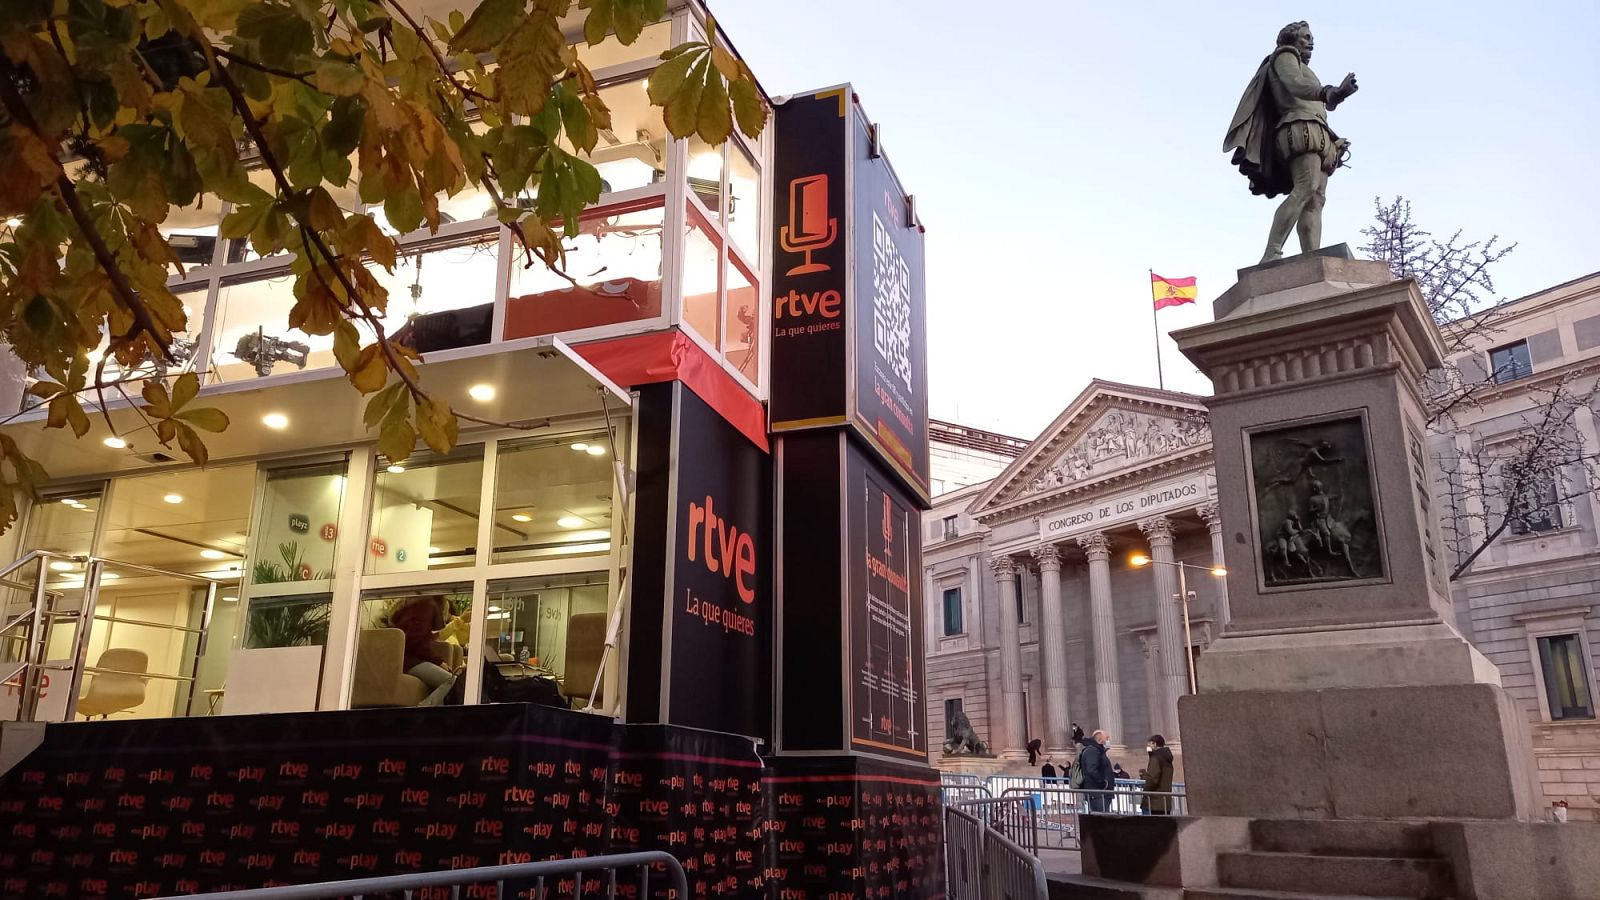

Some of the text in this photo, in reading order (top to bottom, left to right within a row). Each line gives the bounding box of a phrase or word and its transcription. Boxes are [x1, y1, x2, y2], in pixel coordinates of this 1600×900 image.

[775, 289, 841, 319] rtve
[775, 321, 841, 338] La que quieres
[1049, 484, 1197, 532] CONGRESO DE LOS DIPUTADOS
[688, 495, 756, 604] rtve
[686, 588, 755, 636] La que quieres
[280, 760, 309, 778] rtve
[333, 763, 362, 781] play
[378, 756, 407, 776] rtve
[434, 762, 464, 778] play
[481, 755, 510, 774] rtve
[537, 762, 555, 778] play
[565, 760, 581, 776] rtve
[615, 771, 642, 787] rtve
[118, 792, 144, 808] rtve
[208, 792, 235, 809] rtve
[302, 789, 329, 807] rtve
[356, 793, 383, 809] play
[401, 788, 429, 806] rtve
[458, 791, 486, 808] play
[504, 786, 534, 805] rtve
[552, 793, 570, 808] play
[778, 791, 804, 805] rtve
[826, 793, 850, 807] play
[640, 799, 669, 815] rtve
[736, 801, 751, 815] rtve
[271, 819, 300, 836] rtve
[325, 822, 355, 840] play
[373, 817, 399, 837] rtve
[426, 821, 457, 840] play
[475, 818, 503, 836] rtve
[533, 822, 552, 839] play
[585, 821, 602, 837] play
[611, 826, 640, 842] rtve
[764, 820, 787, 832] play
[780, 840, 806, 853] rtve
[828, 842, 853, 856] play
[109, 849, 138, 864] rtve
[248, 853, 275, 869] play
[293, 849, 320, 866] rtve
[350, 853, 378, 870] play
[394, 849, 423, 869] rtve
[451, 854, 480, 870] play
[499, 849, 531, 865] rtve
[736, 849, 752, 863] rtve
[764, 868, 788, 880] play
[135, 880, 160, 896] play
[466, 882, 497, 900] rtve
[558, 878, 575, 894] rtve
[780, 887, 806, 900] rtve
